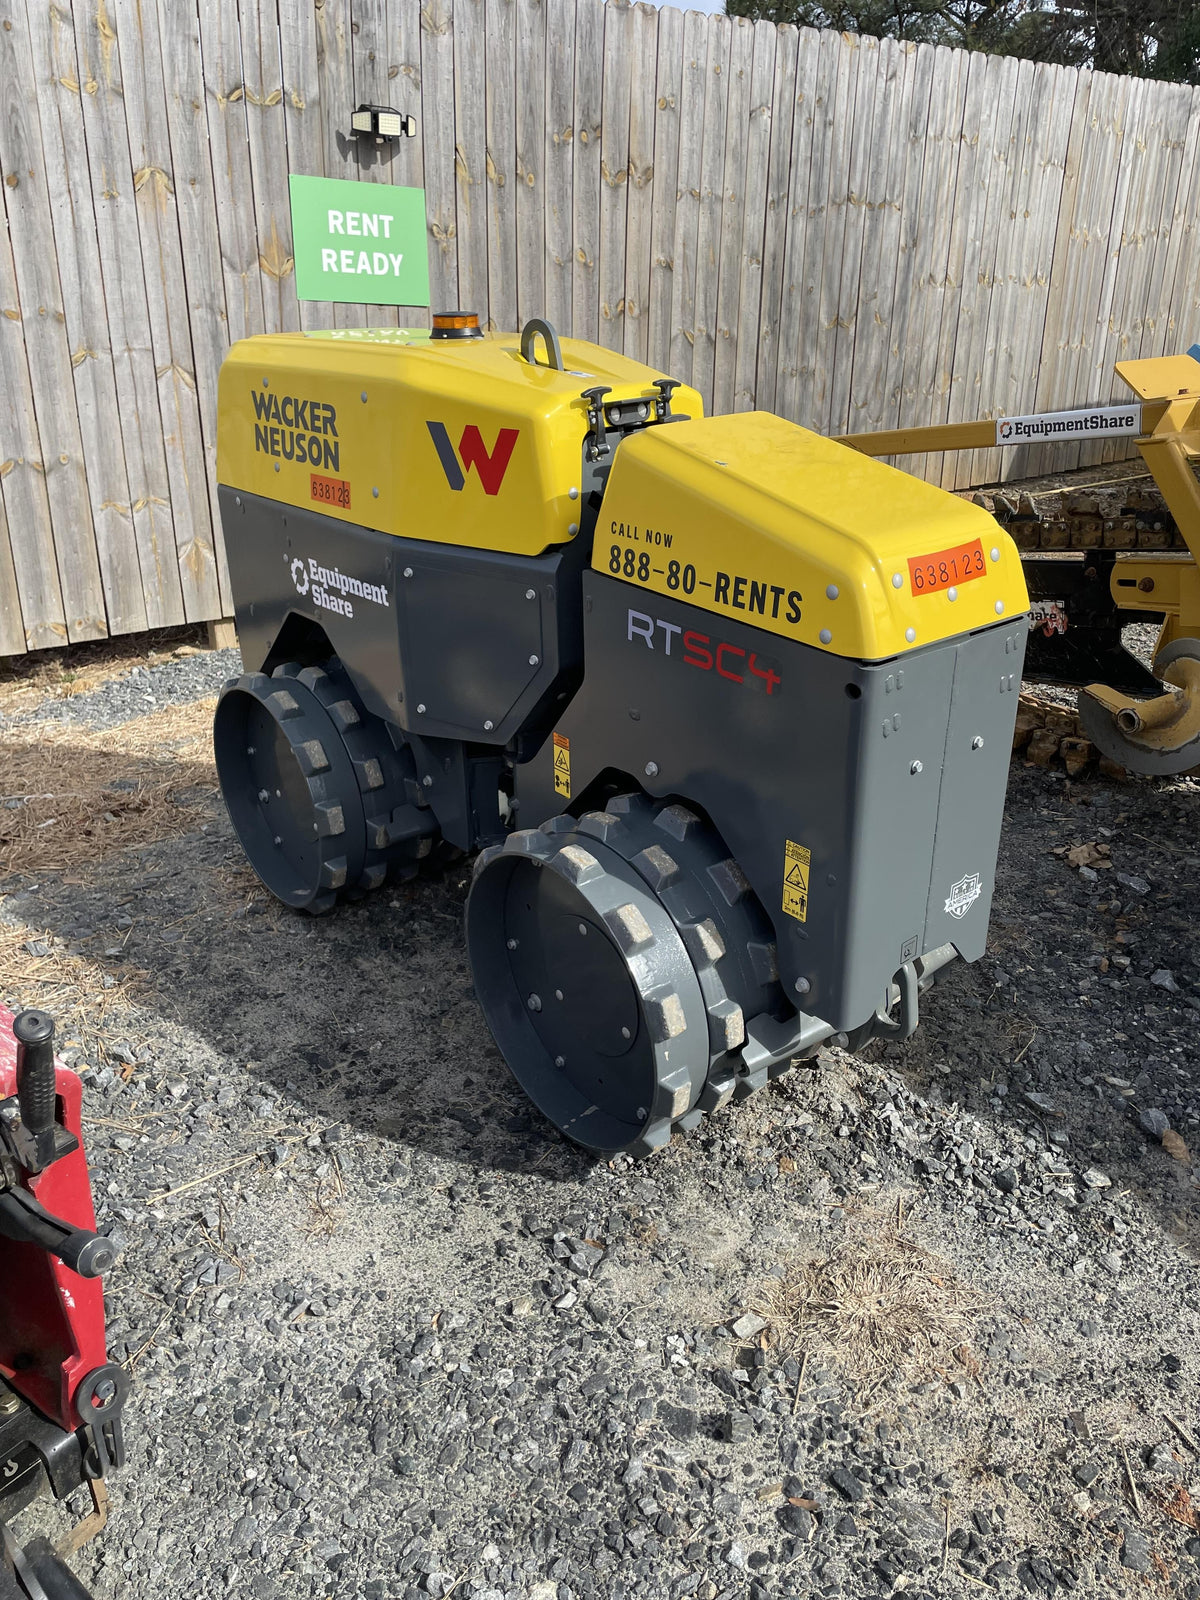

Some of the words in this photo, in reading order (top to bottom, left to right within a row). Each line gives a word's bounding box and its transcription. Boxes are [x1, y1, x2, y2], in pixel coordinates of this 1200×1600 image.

[327, 209, 394, 239] RENT
[321, 248, 404, 277] READY
[251, 390, 339, 438] WACKER
[1014, 415, 1134, 438] EquipmentShare
[254, 423, 340, 472] NEUSON
[312, 481, 350, 505] 638123
[610, 521, 639, 541] CALL
[645, 529, 673, 548] NOW
[307, 557, 389, 607] Equipment
[608, 544, 803, 624] 888-80-RENTS
[914, 550, 984, 589] 638123
[311, 583, 354, 619] Share
[627, 608, 781, 695] RTSC4
